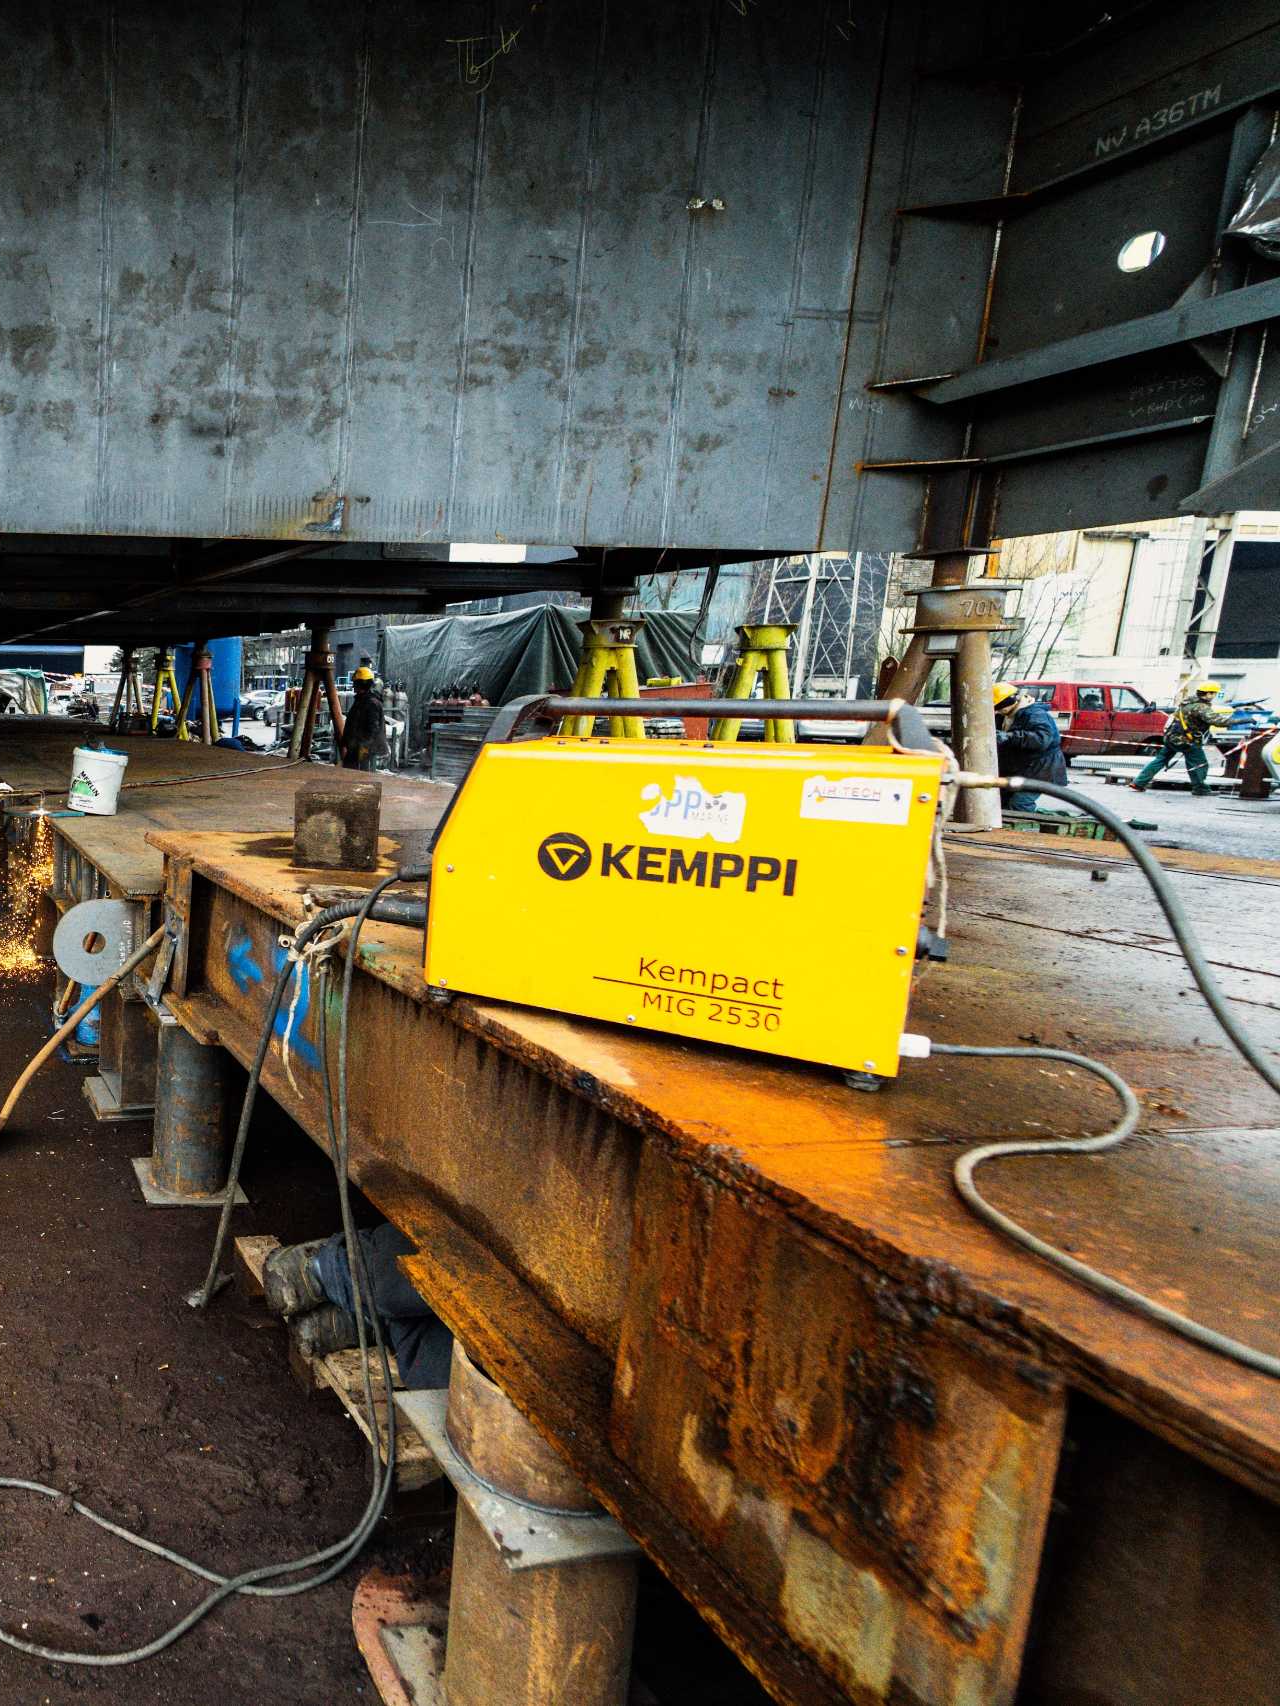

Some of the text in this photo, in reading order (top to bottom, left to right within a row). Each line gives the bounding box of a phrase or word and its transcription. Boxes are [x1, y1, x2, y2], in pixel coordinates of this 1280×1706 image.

[1095, 83, 1223, 157] NV A36TM
[601, 843, 798, 897] KEMPPI
[639, 957, 784, 999] Kempact
[643, 991, 781, 1032] MIG 2530
